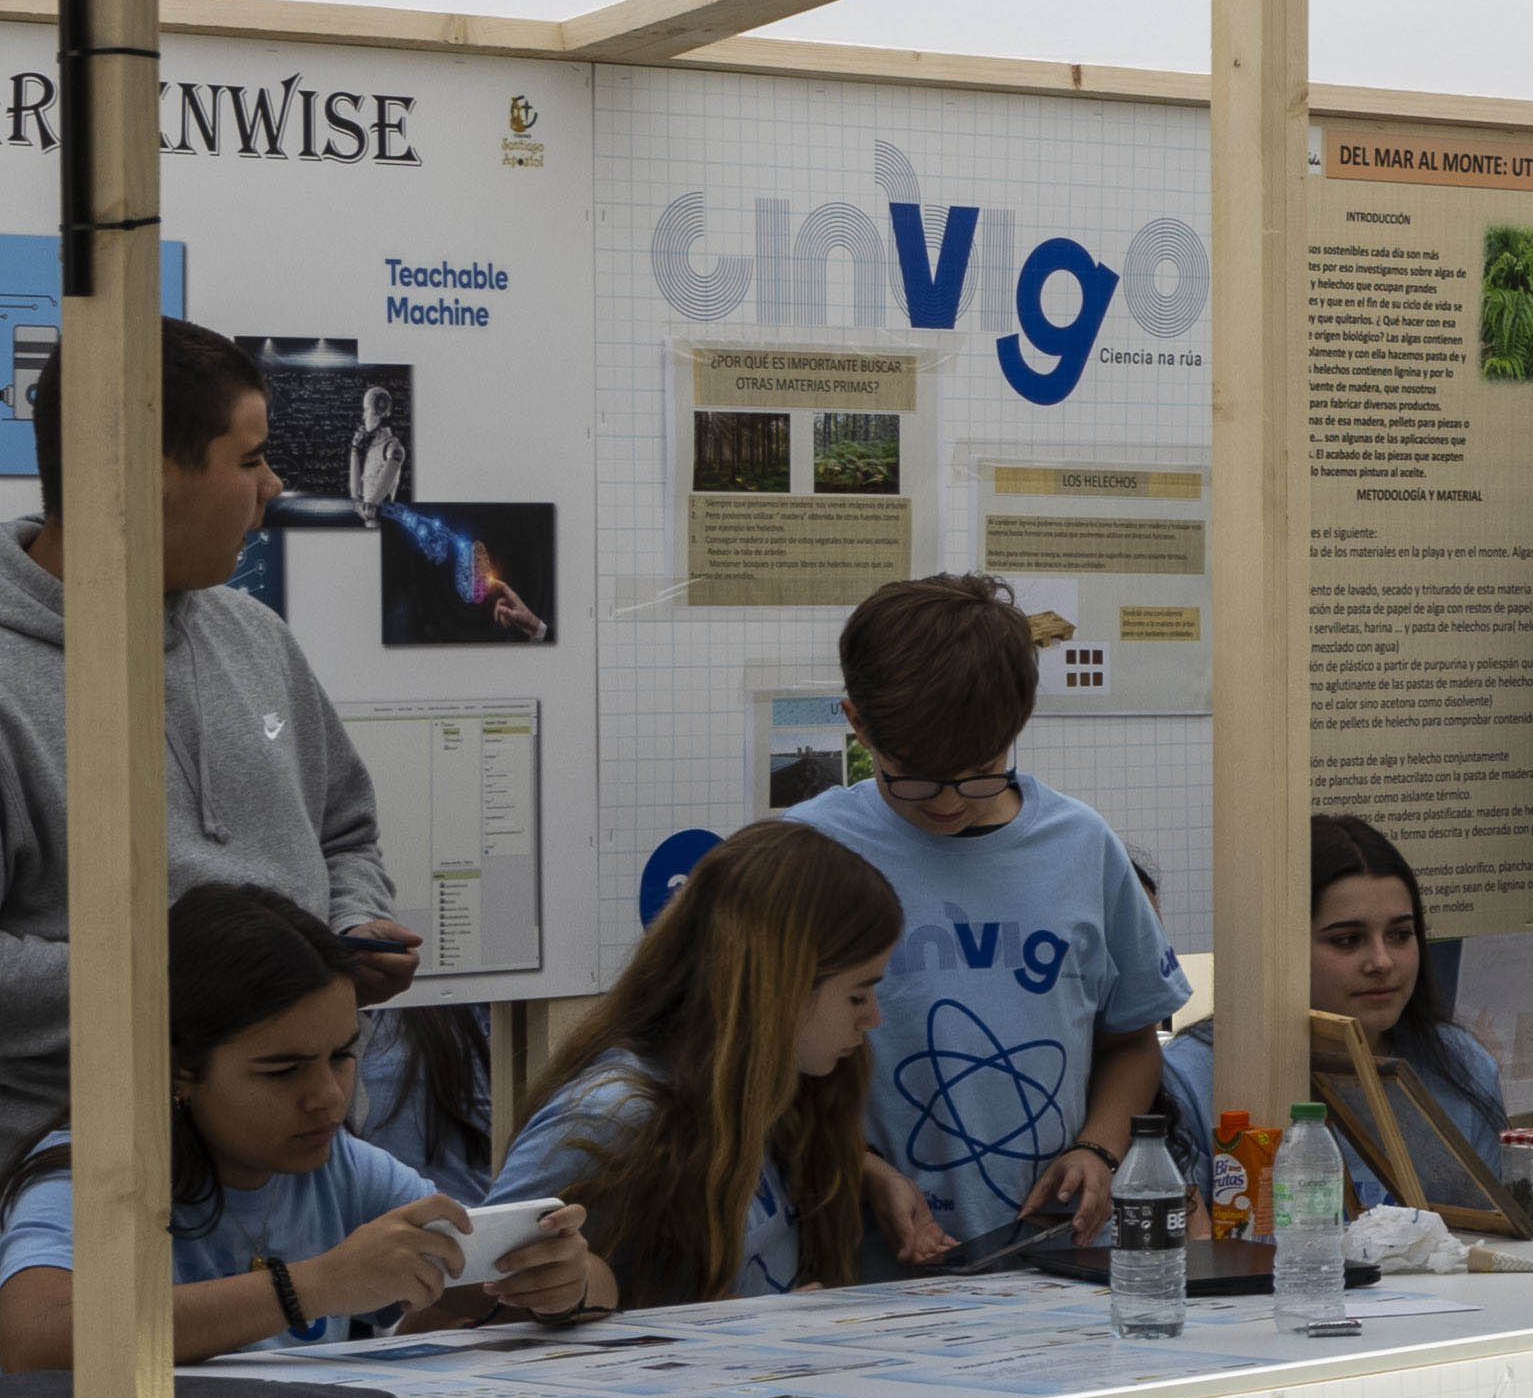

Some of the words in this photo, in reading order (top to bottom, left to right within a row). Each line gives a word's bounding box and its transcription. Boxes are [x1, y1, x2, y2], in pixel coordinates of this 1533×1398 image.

[1340, 145, 1370, 166] DEL
[1375, 148, 1413, 169] MAR
[1418, 151, 1438, 170] AL
[1443, 153, 1508, 175] MONTE:
[1346, 211, 1411, 225] INTRODUCCIÓN
[1323, 245, 1369, 258] sostenibles
[1371, 247, 1390, 258] cada
[1406, 250, 1420, 259] son
[385, 258, 509, 291] Teachable
[1323, 264, 1337, 275] por
[1339, 264, 1353, 273] eso
[1356, 262, 1408, 278] investigamos
[1410, 265, 1432, 277] sobre
[1434, 267, 1454, 280] algas
[1456, 268, 1467, 279] de
[1318, 279, 1354, 291] helechos
[1357, 281, 1372, 292] que
[1374, 283, 1404, 294] ocupan
[1405, 282, 1437, 295] grandes
[387, 296, 490, 327] Machine
[1327, 299, 1343, 309] que
[1345, 299, 1355, 308] en
[1357, 297, 1365, 308] el
[1367, 297, 1378, 309] fin
[1380, 298, 1390, 309] de
[1392, 301, 1401, 310] su
[1403, 299, 1421, 311] ciclo
[1423, 301, 1434, 311] de
[1435, 300, 1451, 312] vida
[1453, 303, 1463, 313] se
[1314, 329, 1341, 344] origen
[1343, 330, 1384, 344] biológico?
[1387, 332, 1398, 343] Las
[1401, 332, 1421, 346] algas
[1423, 334, 1463, 346] contienen
[711, 354, 741, 370] ¿POR
[744, 354, 769, 370] QUÉ
[772, 356, 785, 370] ES
[788, 357, 857, 373] IMPORTANTE
[861, 359, 901, 374] BUSCAR
[1100, 347, 1154, 367] Ciencia
[1158, 351, 1176, 367] na
[1179, 347, 1203, 368] rúa
[1313, 363, 1350, 376] helechos
[1352, 365, 1392, 377] contienen
[1395, 366, 1421, 380] lignina
[1430, 369, 1443, 379] por
[736, 377, 773, 391] OTRAS
[776, 378, 830, 393] MATERIAS
[834, 380, 880, 394] PRIMAS?
[1310, 400, 1328, 411] para
[1330, 397, 1362, 410] fabricar
[1364, 398, 1397, 410] diversos
[1399, 400, 1442, 412] productos.
[1321, 465, 1357, 477] hacemos
[1359, 467, 1389, 480] pintura
[1390, 467, 1399, 478] al
[1400, 468, 1427, 478] aceite.
[1063, 474, 1082, 487] LOS
[1085, 475, 1137, 489] HELECHOS
[1356, 487, 1426, 502] METODOLOGÍA
[1429, 489, 1435, 501] Y
[1437, 488, 1483, 502] MATERIAL
[1215, 1159, 1228, 1175] Bi
[1213, 1173, 1244, 1189] rutas
